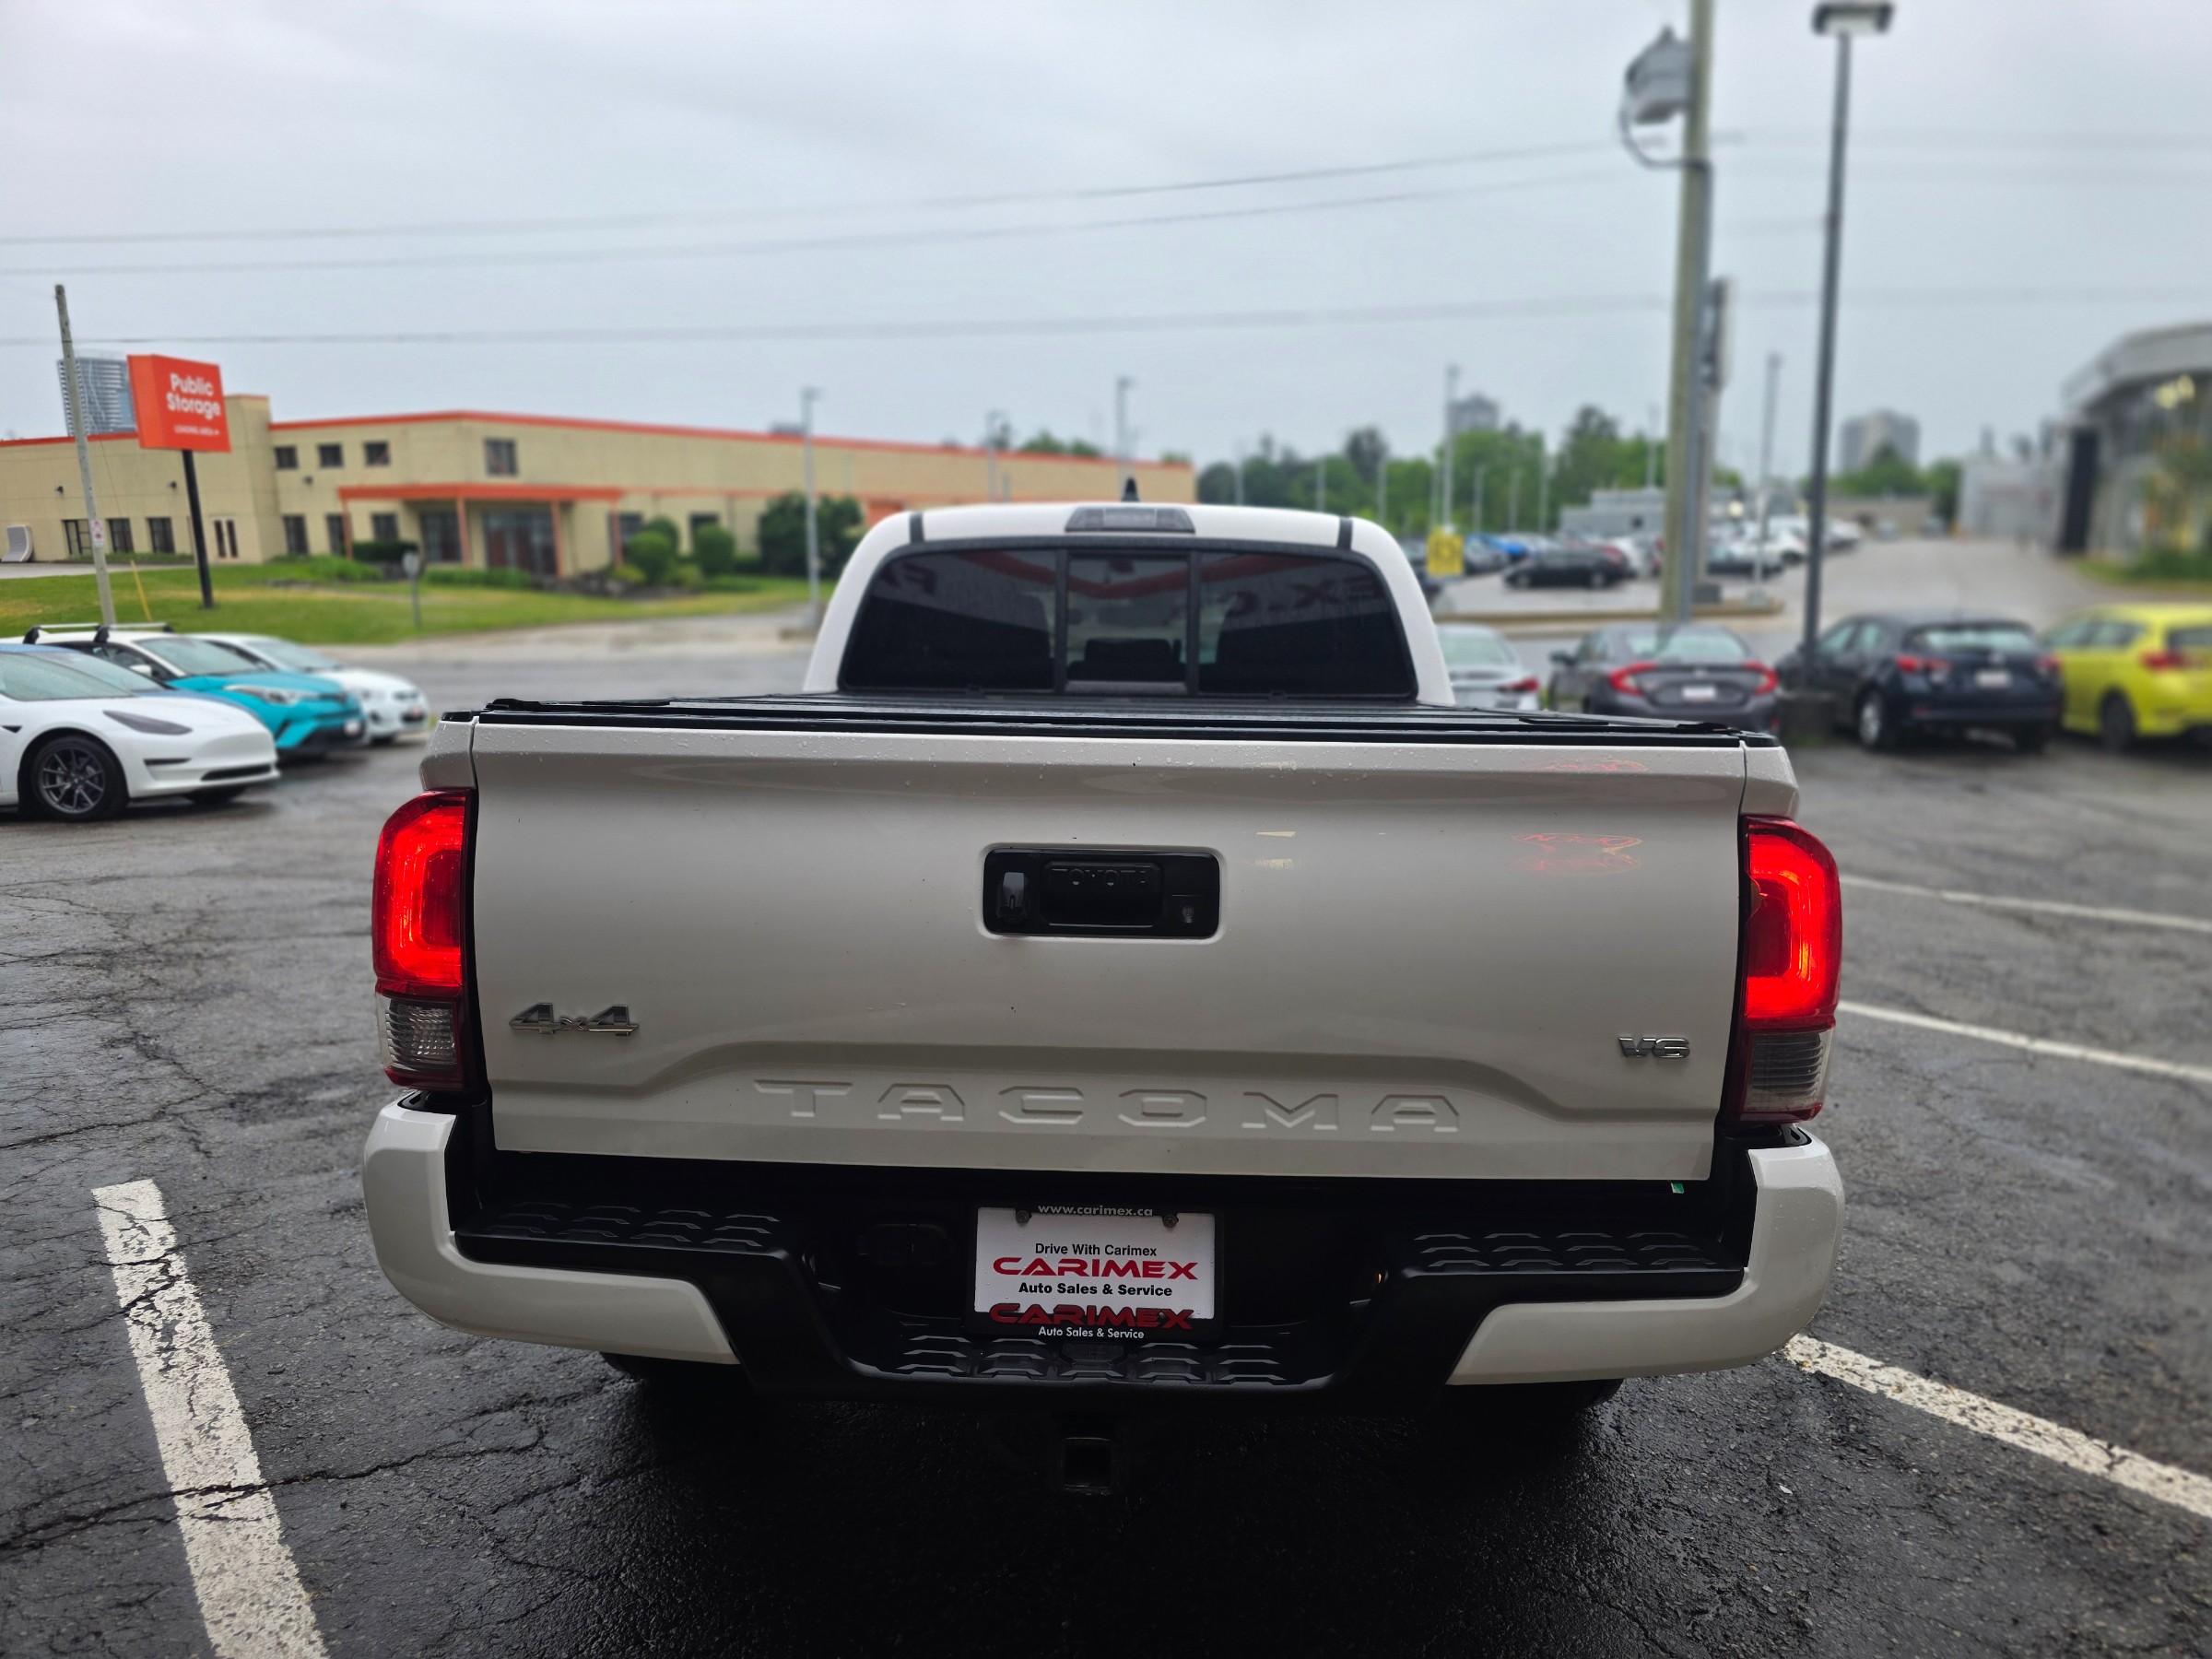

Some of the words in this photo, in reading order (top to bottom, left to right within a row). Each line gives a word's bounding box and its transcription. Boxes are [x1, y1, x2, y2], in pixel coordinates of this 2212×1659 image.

[170, 372, 214, 396] Public
[167, 392, 221, 420] Storage
[1618, 1036, 1690, 1059] V6
[754, 1078, 1460, 1133] TACOMA
[1038, 1205, 1153, 1218] www.carimex.ca
[1035, 1243, 1068, 1255] Drive
[1072, 1243, 1100, 1255] With
[1104, 1244, 1158, 1256] Carimex
[993, 1257, 1199, 1280] CARIMEX
[1018, 1282, 1053, 1295] Auto
[1056, 1283, 1098, 1295] Sales
[1102, 1284, 1113, 1295] &
[1117, 1284, 1173, 1297] Service
[989, 1302, 1194, 1330] CARIMEX
[1038, 1326, 1064, 1337] Auto
[1065, 1327, 1094, 1338] Sales
[1097, 1328, 1105, 1338] &
[1107, 1328, 1145, 1339] Service
